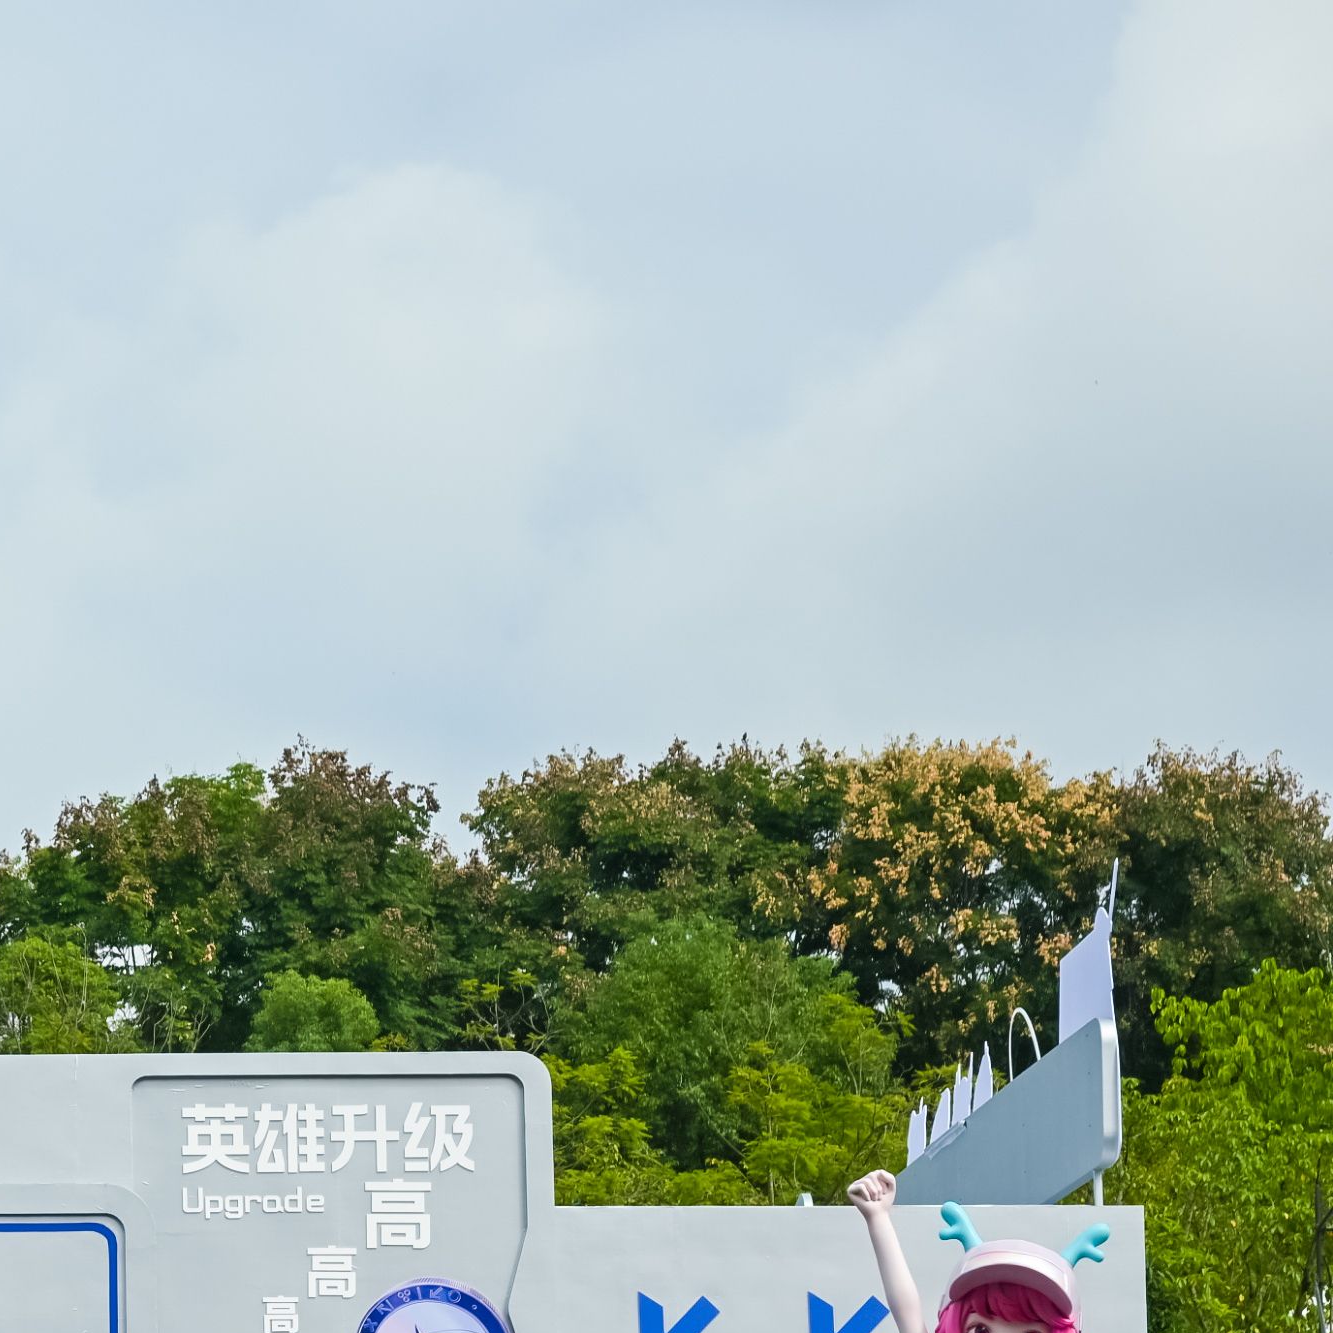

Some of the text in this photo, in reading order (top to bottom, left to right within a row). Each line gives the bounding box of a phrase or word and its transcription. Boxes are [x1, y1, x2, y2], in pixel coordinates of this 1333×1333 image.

[181, 1102, 475, 1175] 英雄升级
[181, 1186, 325, 1220] Upgrade
[363, 1178, 432, 1250] 高
[306, 1245, 357, 1299] 高
